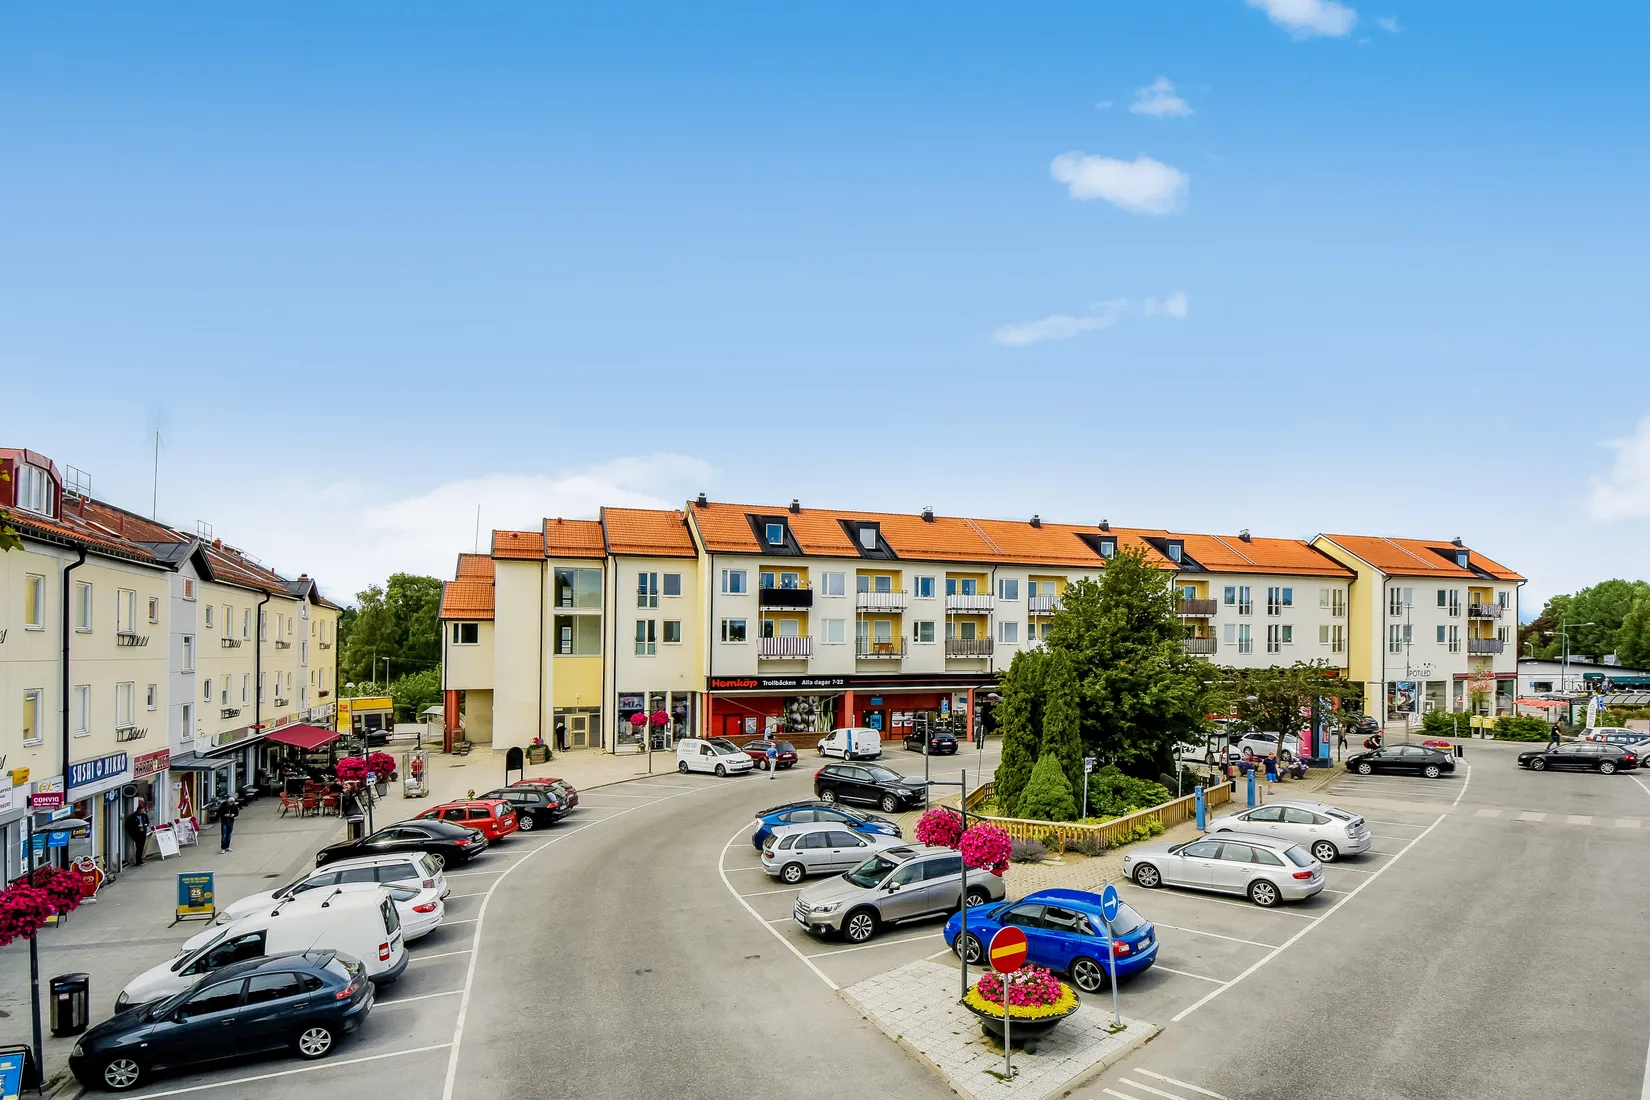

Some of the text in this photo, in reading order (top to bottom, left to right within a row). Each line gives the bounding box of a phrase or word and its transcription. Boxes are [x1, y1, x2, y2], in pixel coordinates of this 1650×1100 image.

[711, 678, 758, 688] Hemköp
[813, 679, 831, 687] dagar
[72, 754, 126, 784] SUSHI NIKKO
